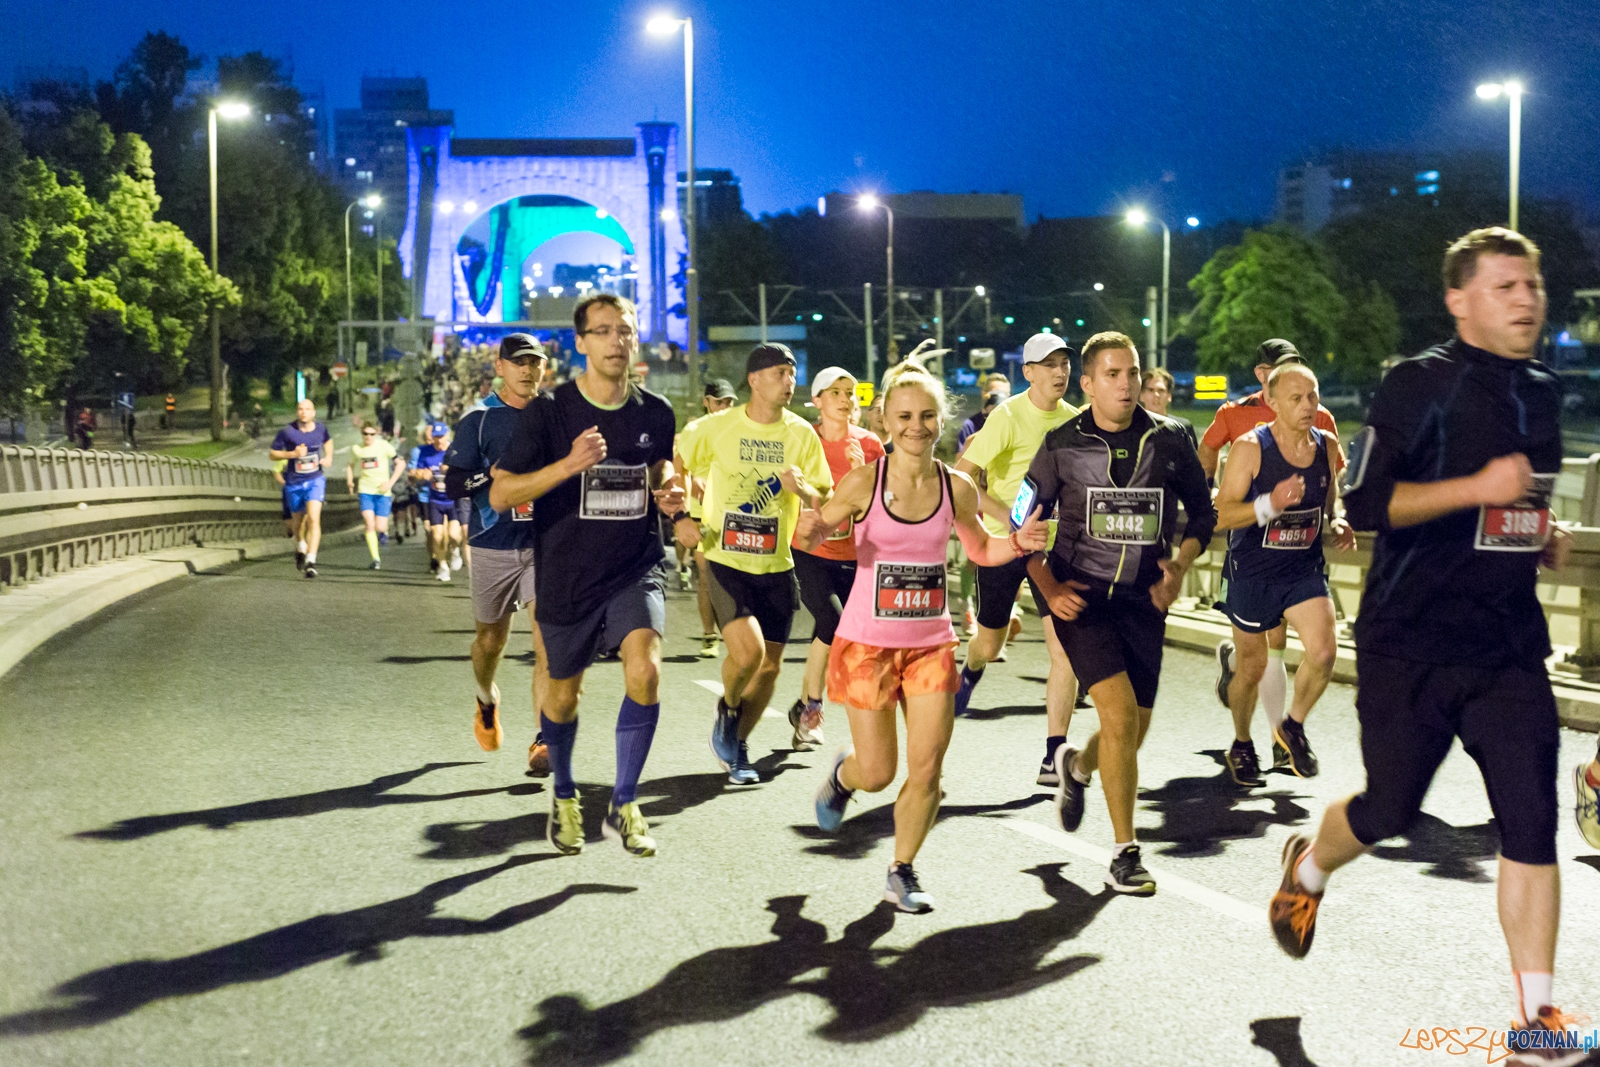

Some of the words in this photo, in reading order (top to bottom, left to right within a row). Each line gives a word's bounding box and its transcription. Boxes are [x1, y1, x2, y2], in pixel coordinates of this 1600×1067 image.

[756, 455, 784, 464] BIEG
[1105, 515, 1144, 532] 3442
[736, 533, 765, 548] 3512
[1279, 530, 1307, 541] 5654
[894, 591, 931, 608] 4144
